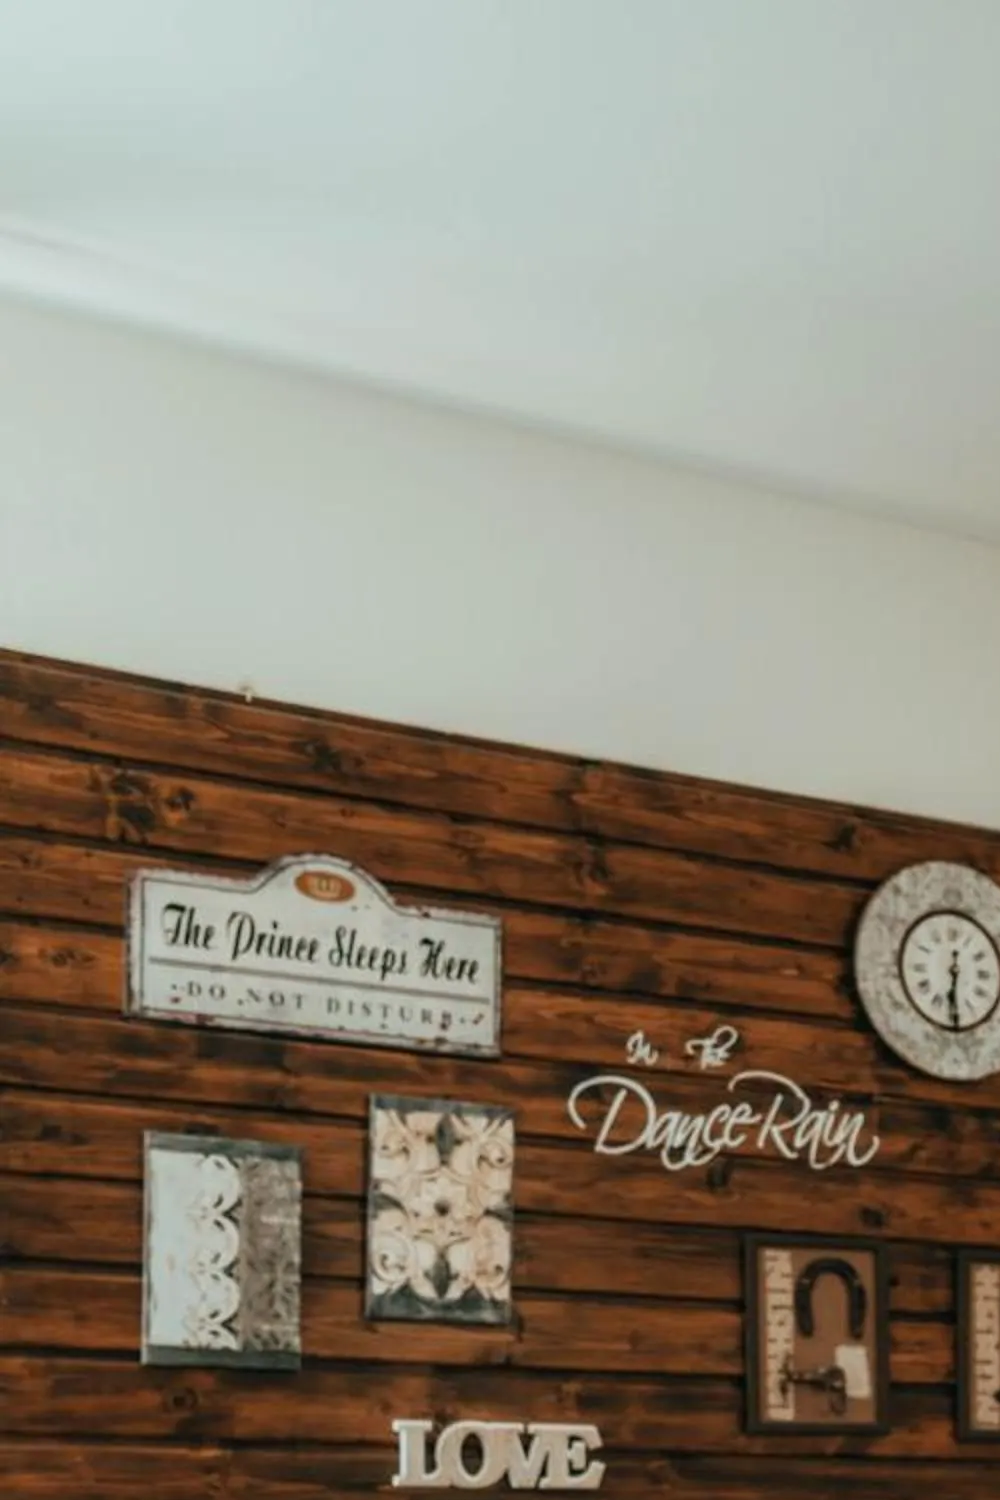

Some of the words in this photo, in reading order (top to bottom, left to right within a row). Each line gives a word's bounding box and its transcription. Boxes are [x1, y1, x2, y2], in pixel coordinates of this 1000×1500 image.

[162, 903, 215, 951] The
[226, 909, 321, 963] Prince
[328, 925, 409, 982] Sleeps
[418, 937, 481, 985] Here
[186, 980, 227, 1001] DO
[246, 987, 307, 1010] NOT
[325, 997, 453, 1026] DISTURB
[567, 1075, 763, 1171] Dance
[727, 1070, 880, 1170] Rain
[391, 1419, 607, 1490] LOVE
